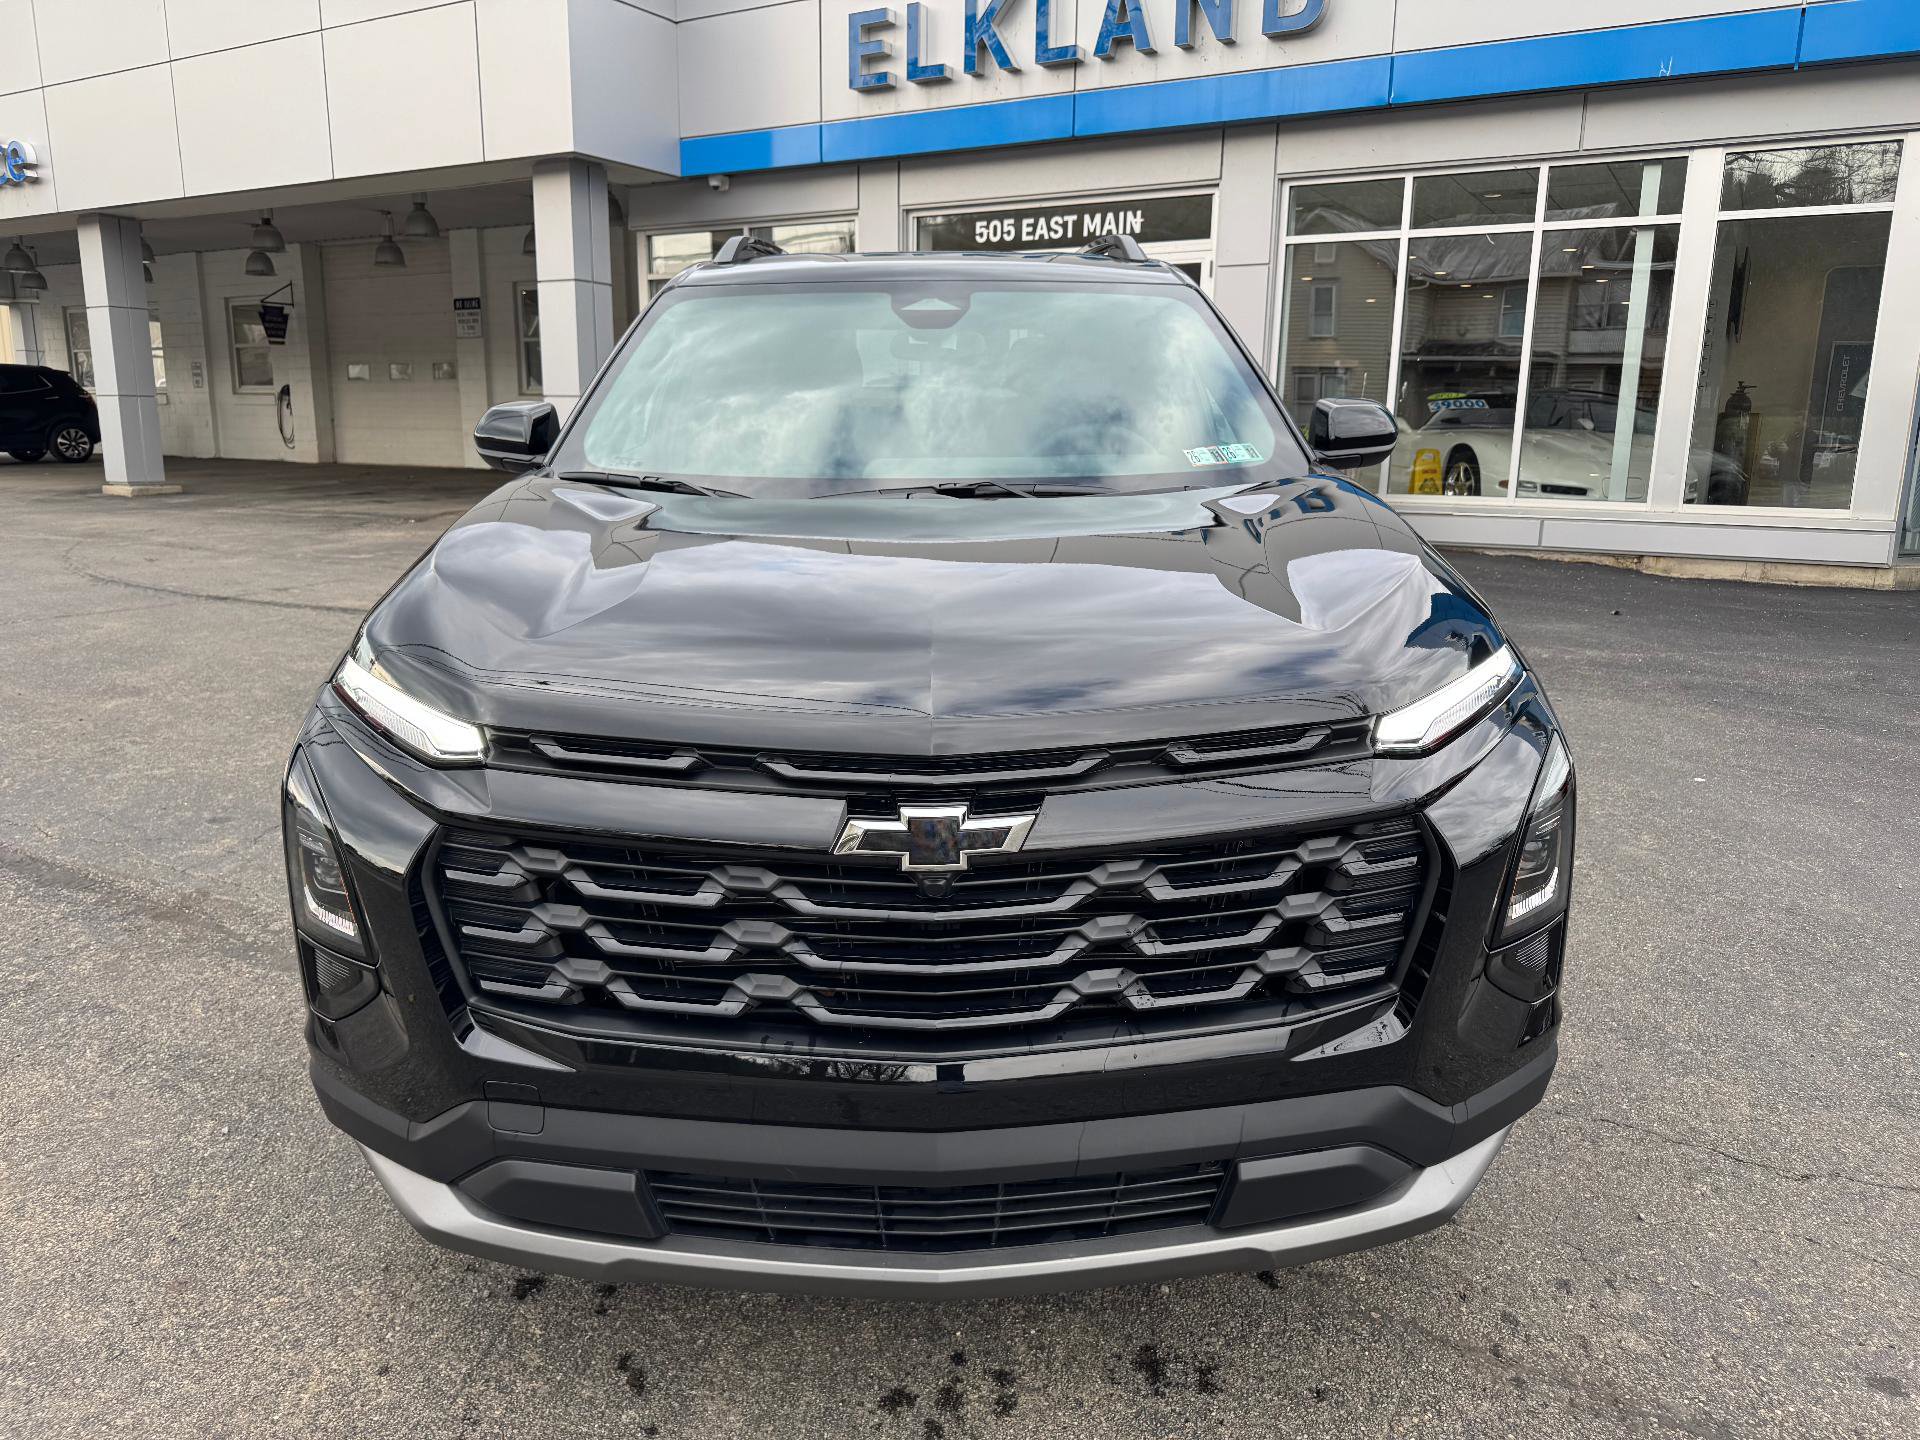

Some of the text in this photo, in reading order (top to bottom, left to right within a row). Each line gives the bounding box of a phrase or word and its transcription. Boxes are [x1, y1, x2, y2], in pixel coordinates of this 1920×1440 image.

[975, 210, 1143, 243] 505 EAST MAIN
[1836, 354, 1851, 412] CHEVROLET
